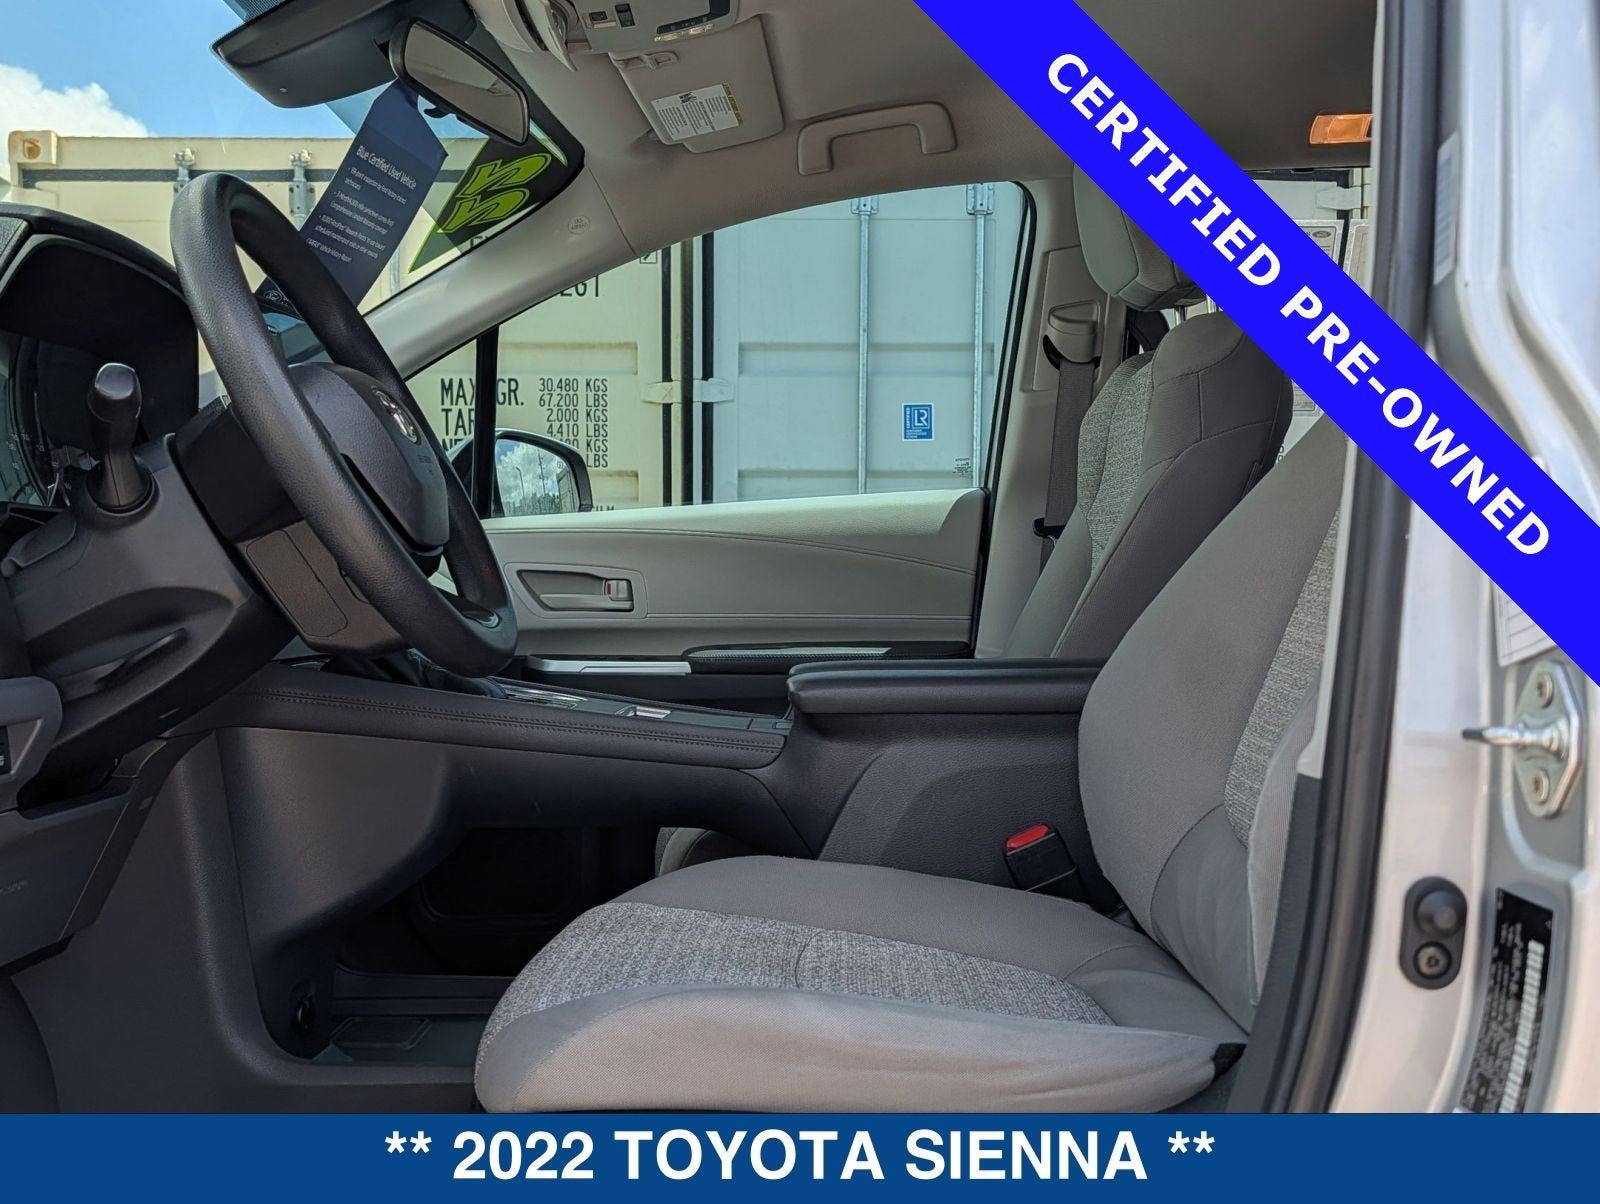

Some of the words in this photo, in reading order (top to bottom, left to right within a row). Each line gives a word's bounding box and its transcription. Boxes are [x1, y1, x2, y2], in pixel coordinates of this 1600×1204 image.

[496, 378, 525, 406] GR.
[585, 377, 608, 393] KGS
[585, 393, 608, 408] LBS
[585, 408, 608, 423] KGS
[585, 423, 608, 438] LBS
[585, 438, 608, 453] KGS
[585, 453, 609, 469] LBS
